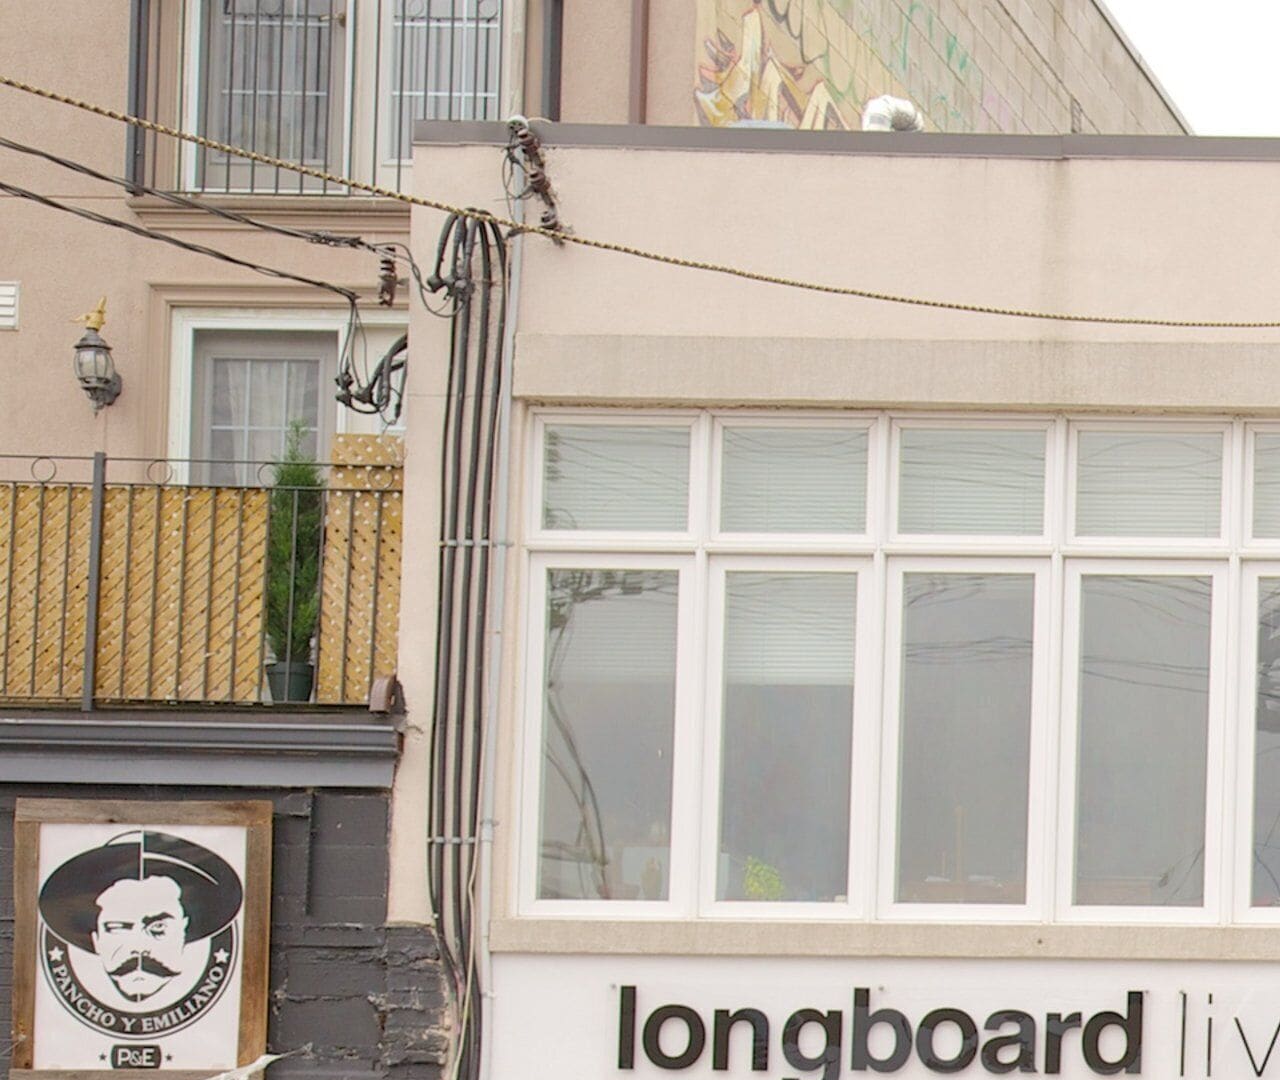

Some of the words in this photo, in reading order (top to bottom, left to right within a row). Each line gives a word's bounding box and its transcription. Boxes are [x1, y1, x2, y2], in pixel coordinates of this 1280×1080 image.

[52, 963, 117, 1028] PANCHO
[122, 1017, 137, 1032] Y
[142, 966, 224, 1033] EMILIANO
[117, 1048, 155, 1067] P&E
